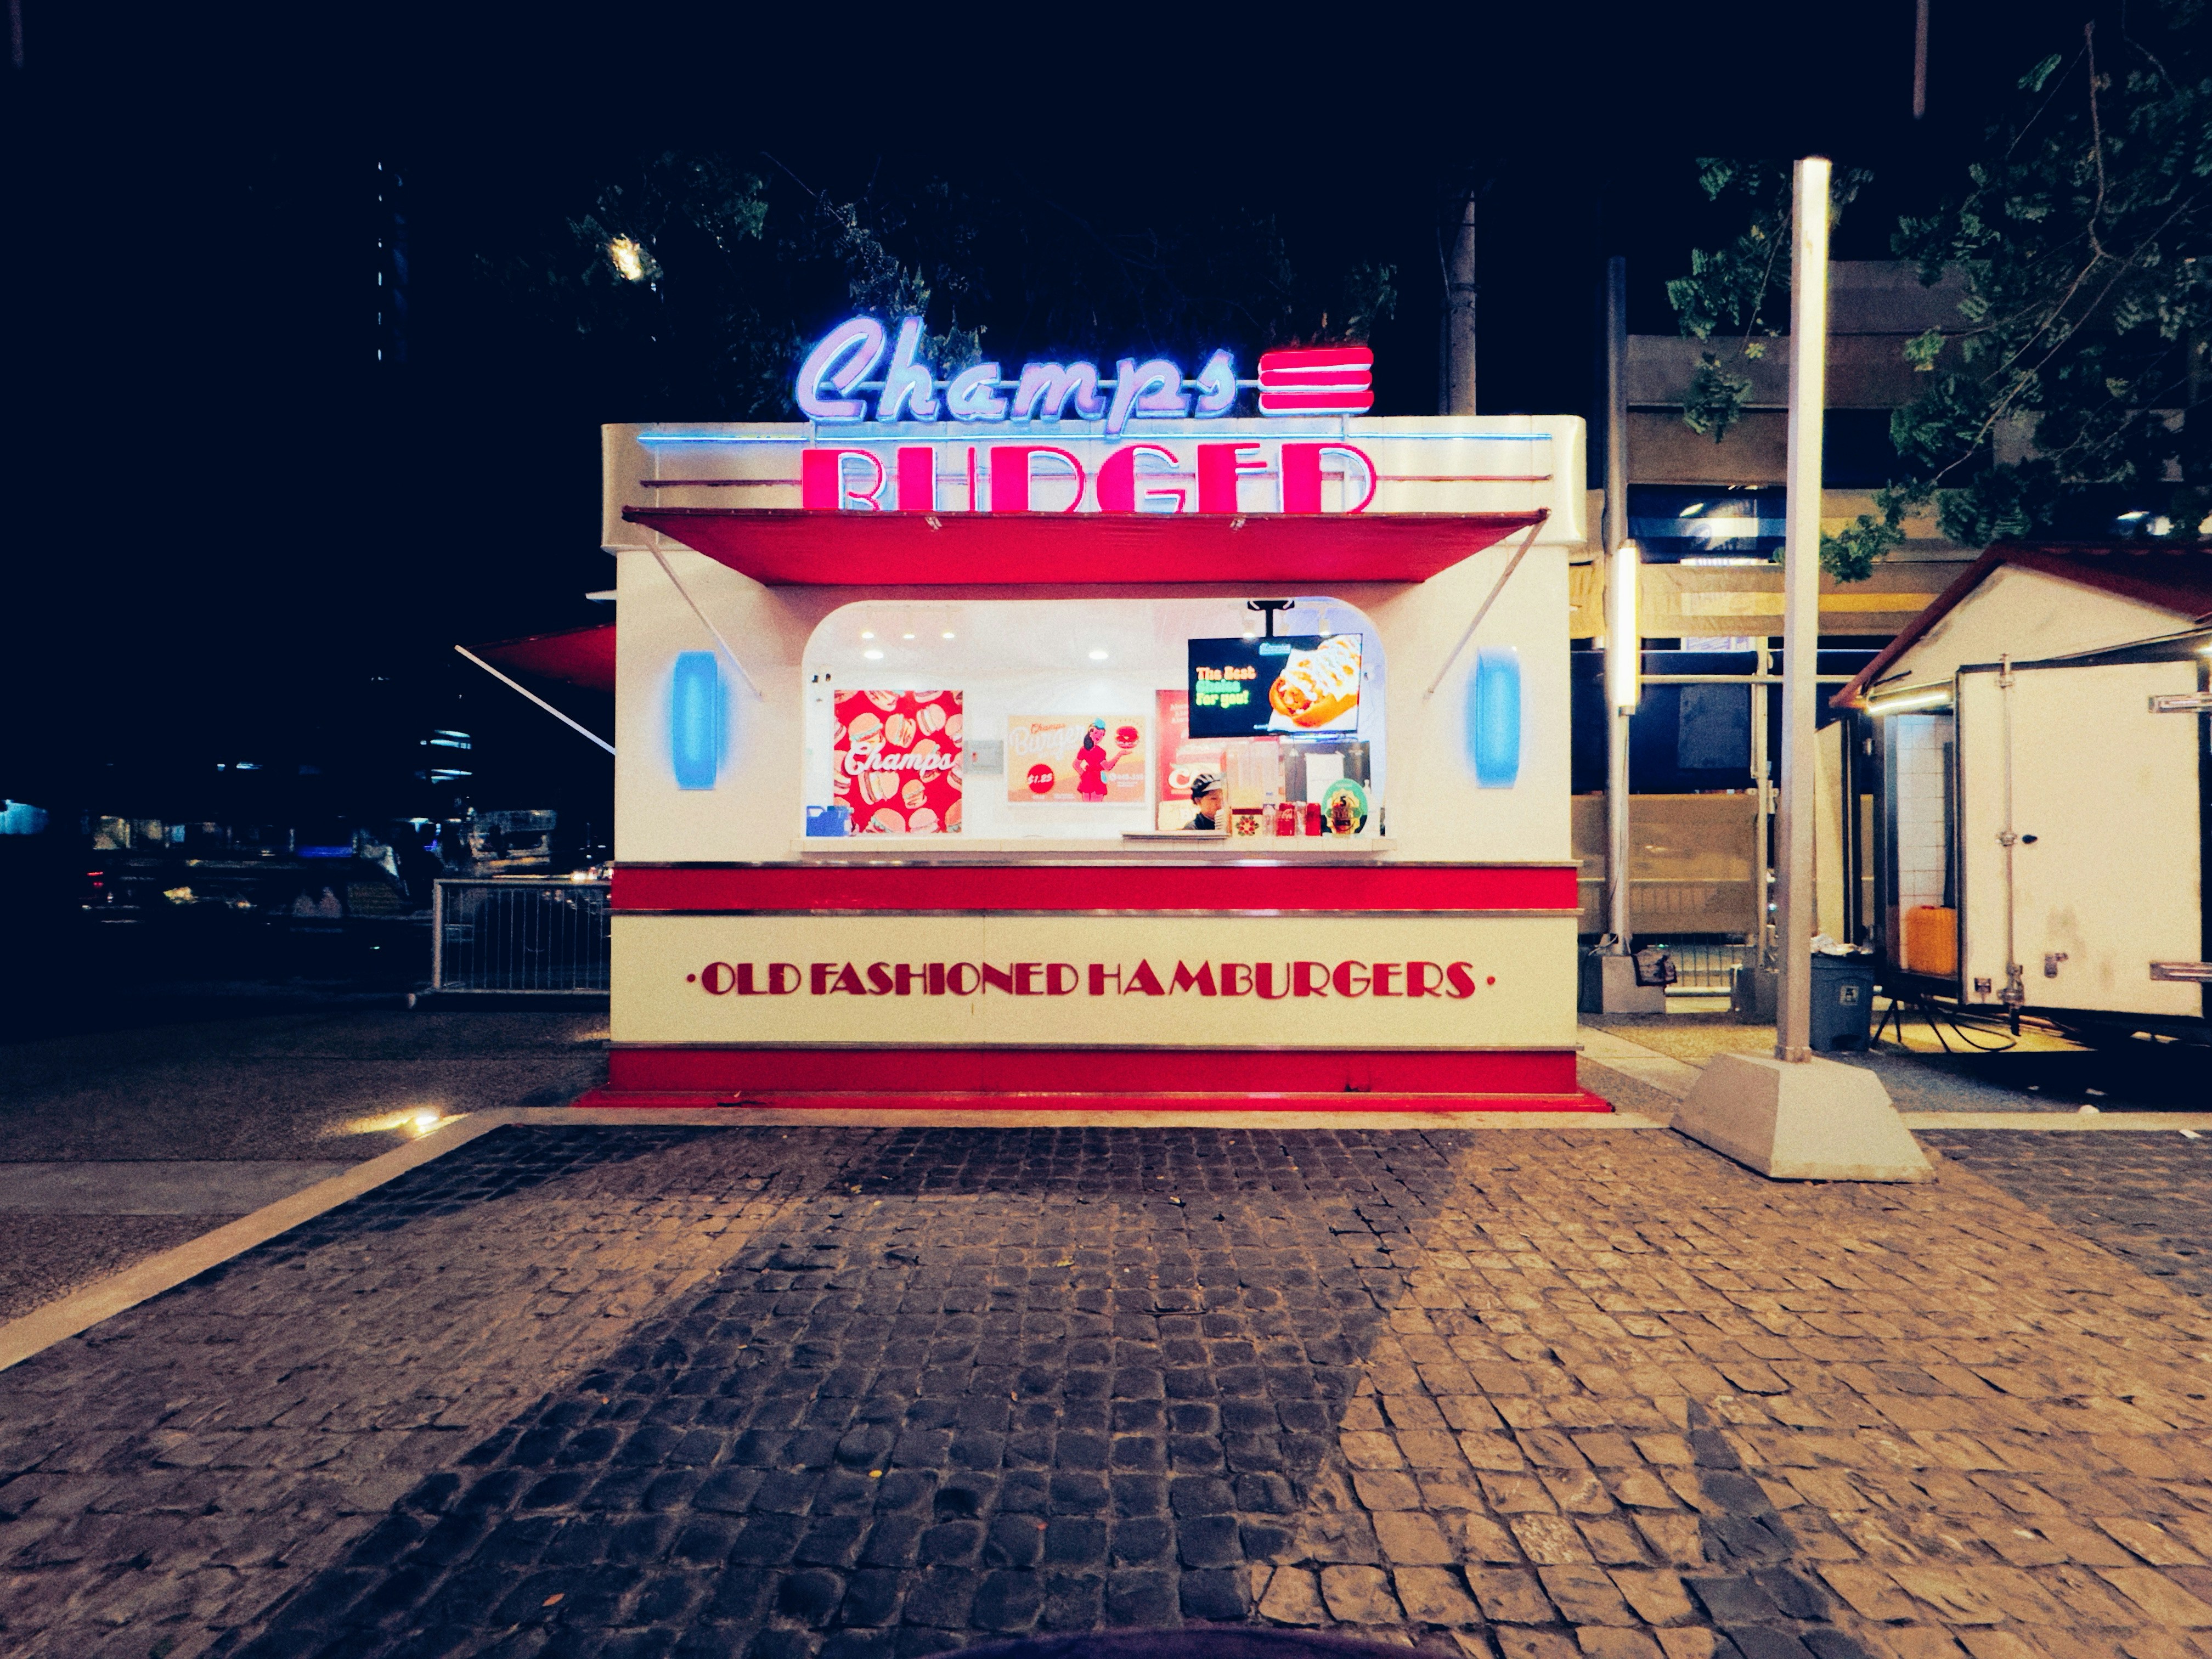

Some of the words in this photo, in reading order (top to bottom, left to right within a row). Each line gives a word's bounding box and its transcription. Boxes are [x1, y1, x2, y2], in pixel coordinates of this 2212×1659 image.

[797, 315, 1238, 439] Champs
[1195, 666, 1222, 680] The
[1224, 665, 1256, 680] Best
[1030, 723, 1065, 734] Champs
[845, 742, 955, 776] Champs
[701, 961, 802, 996] OLD
[810, 961, 1079, 996] FASHIONED
[1088, 958, 1476, 1000] HAMBURGERS
